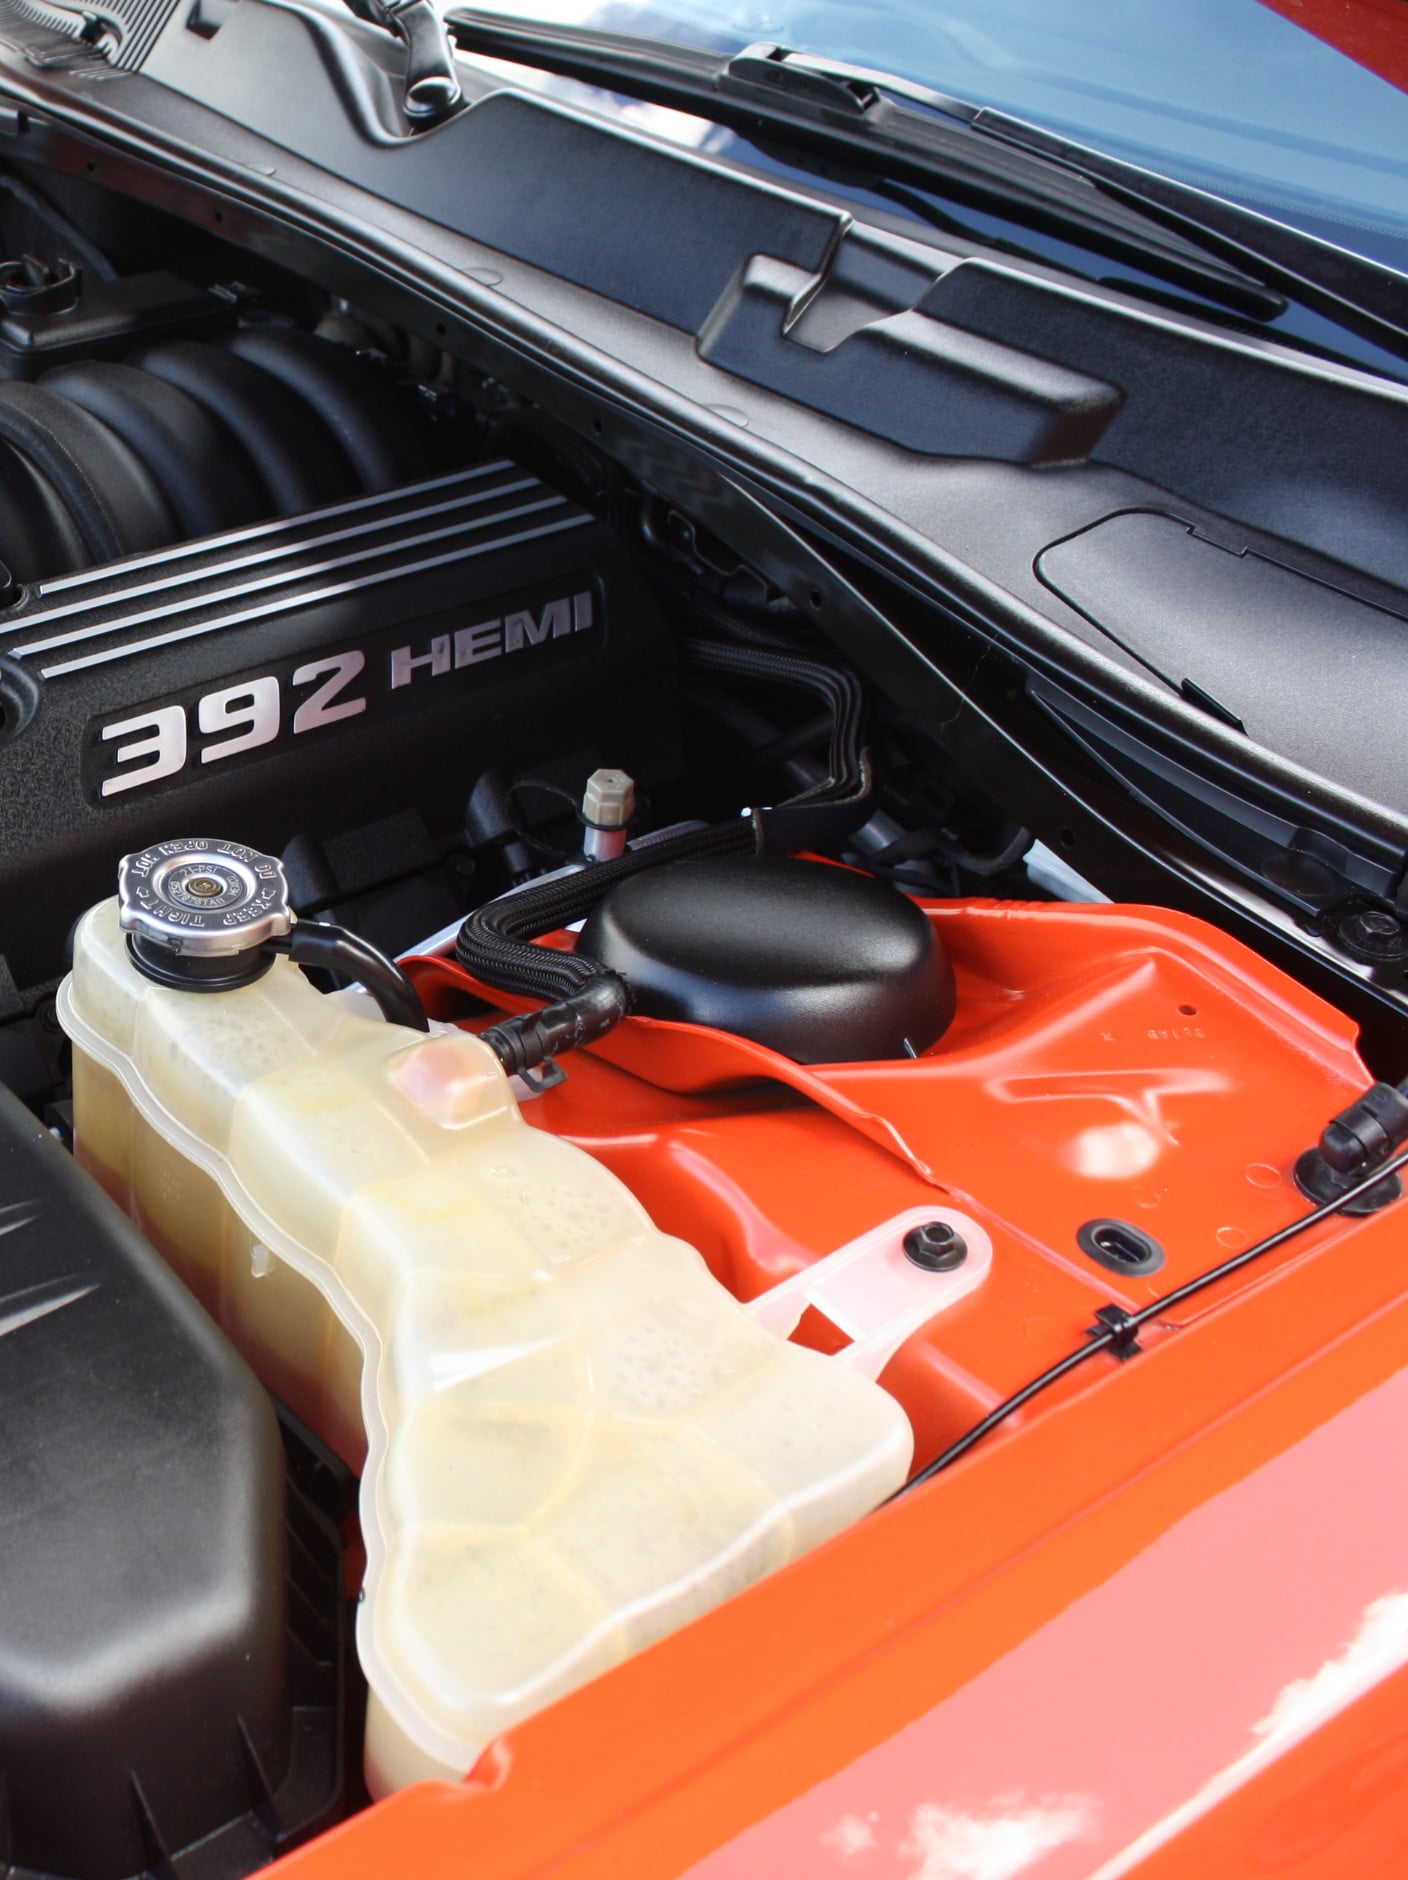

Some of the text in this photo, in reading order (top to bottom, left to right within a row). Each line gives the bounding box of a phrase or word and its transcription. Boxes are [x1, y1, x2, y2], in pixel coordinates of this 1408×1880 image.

[100, 590, 593, 797] 392 HEMI
[159, 841, 209, 856] OPEN
[217, 844, 257, 862] NOT
[254, 863, 277, 880] DO
[139, 899, 271, 927] KEEP TIGHT
